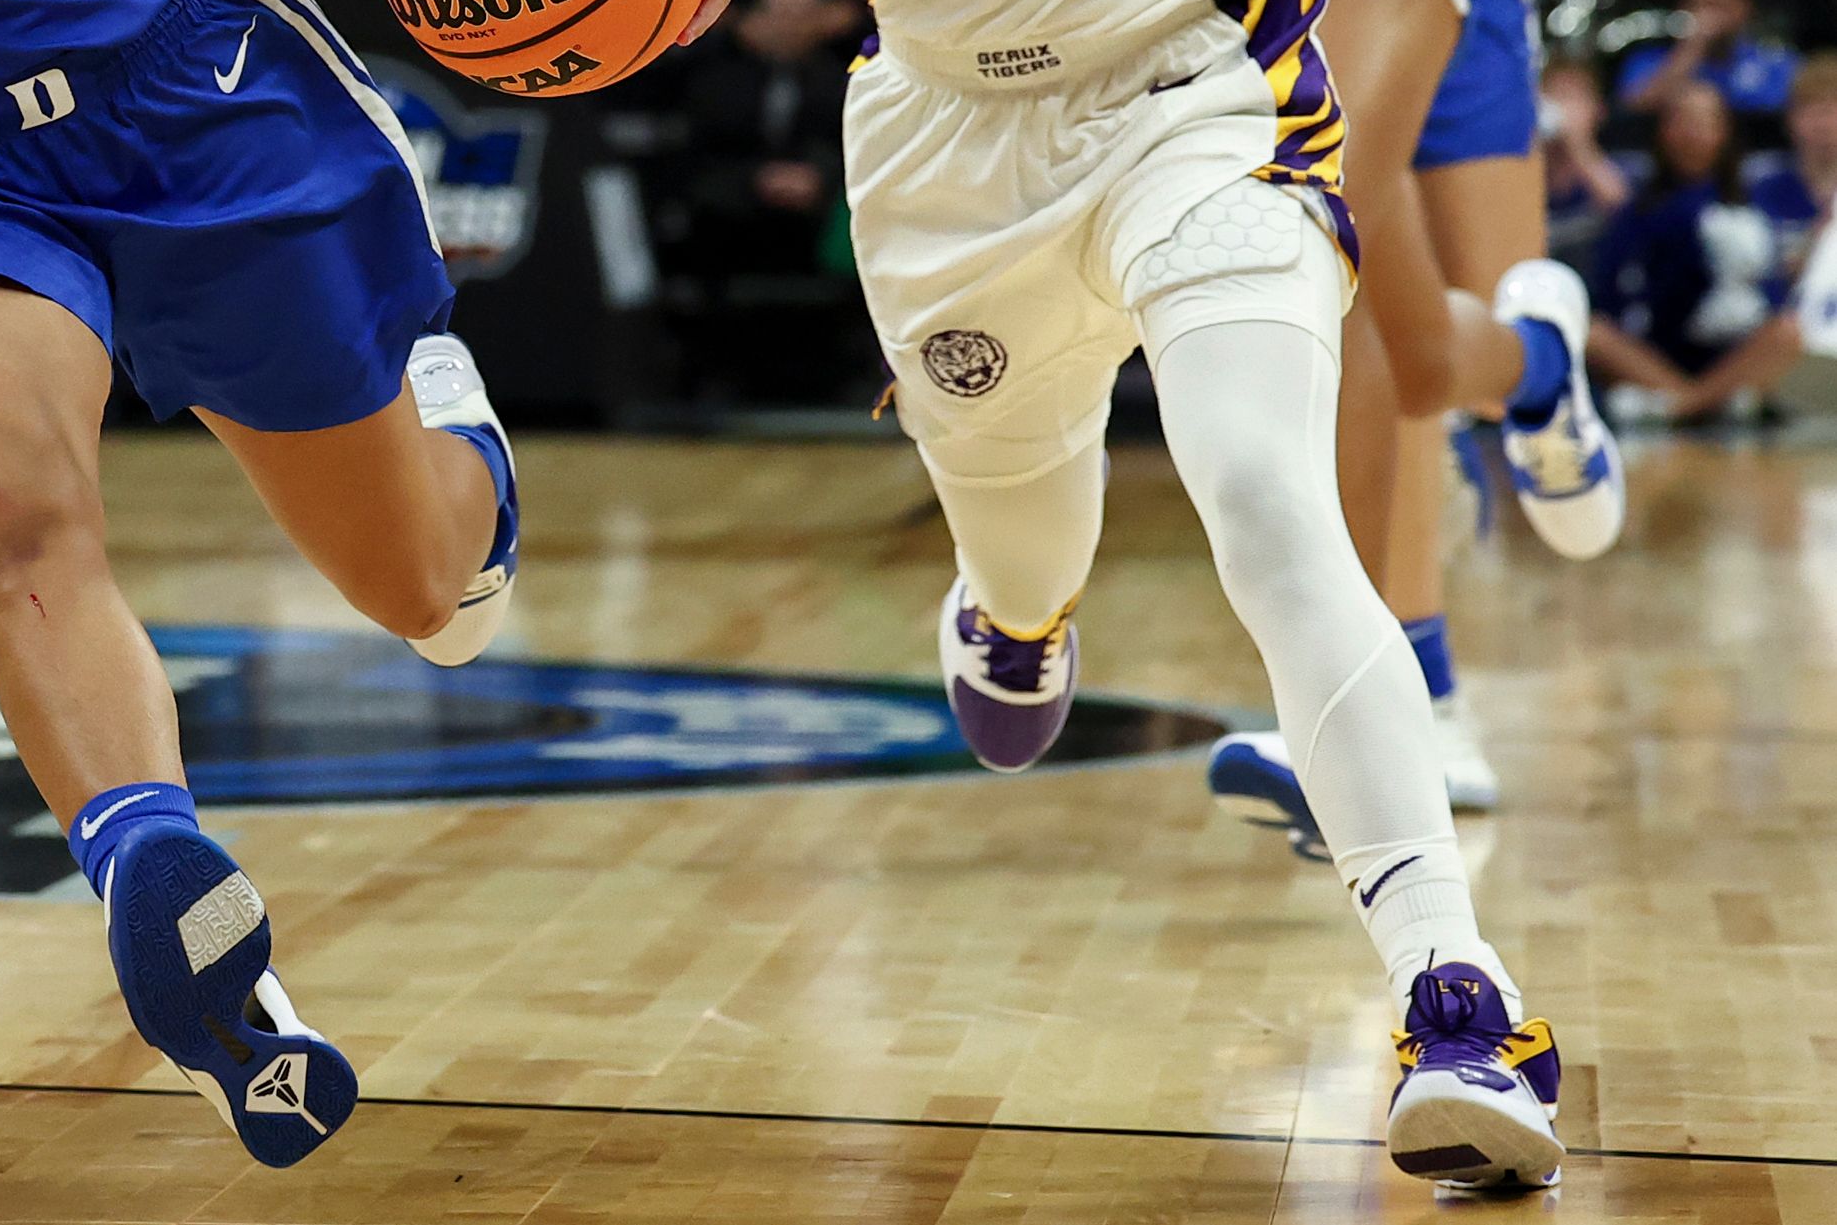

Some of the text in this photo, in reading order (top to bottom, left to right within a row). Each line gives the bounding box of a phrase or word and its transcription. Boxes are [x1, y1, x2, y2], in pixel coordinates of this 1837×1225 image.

[438, 28, 497, 41] EVO NXT
[977, 43, 1052, 65] GEAUX
[977, 56, 1061, 78] TIGERS
[4, 68, 75, 131] D
[1438, 979, 1480, 995] LU
